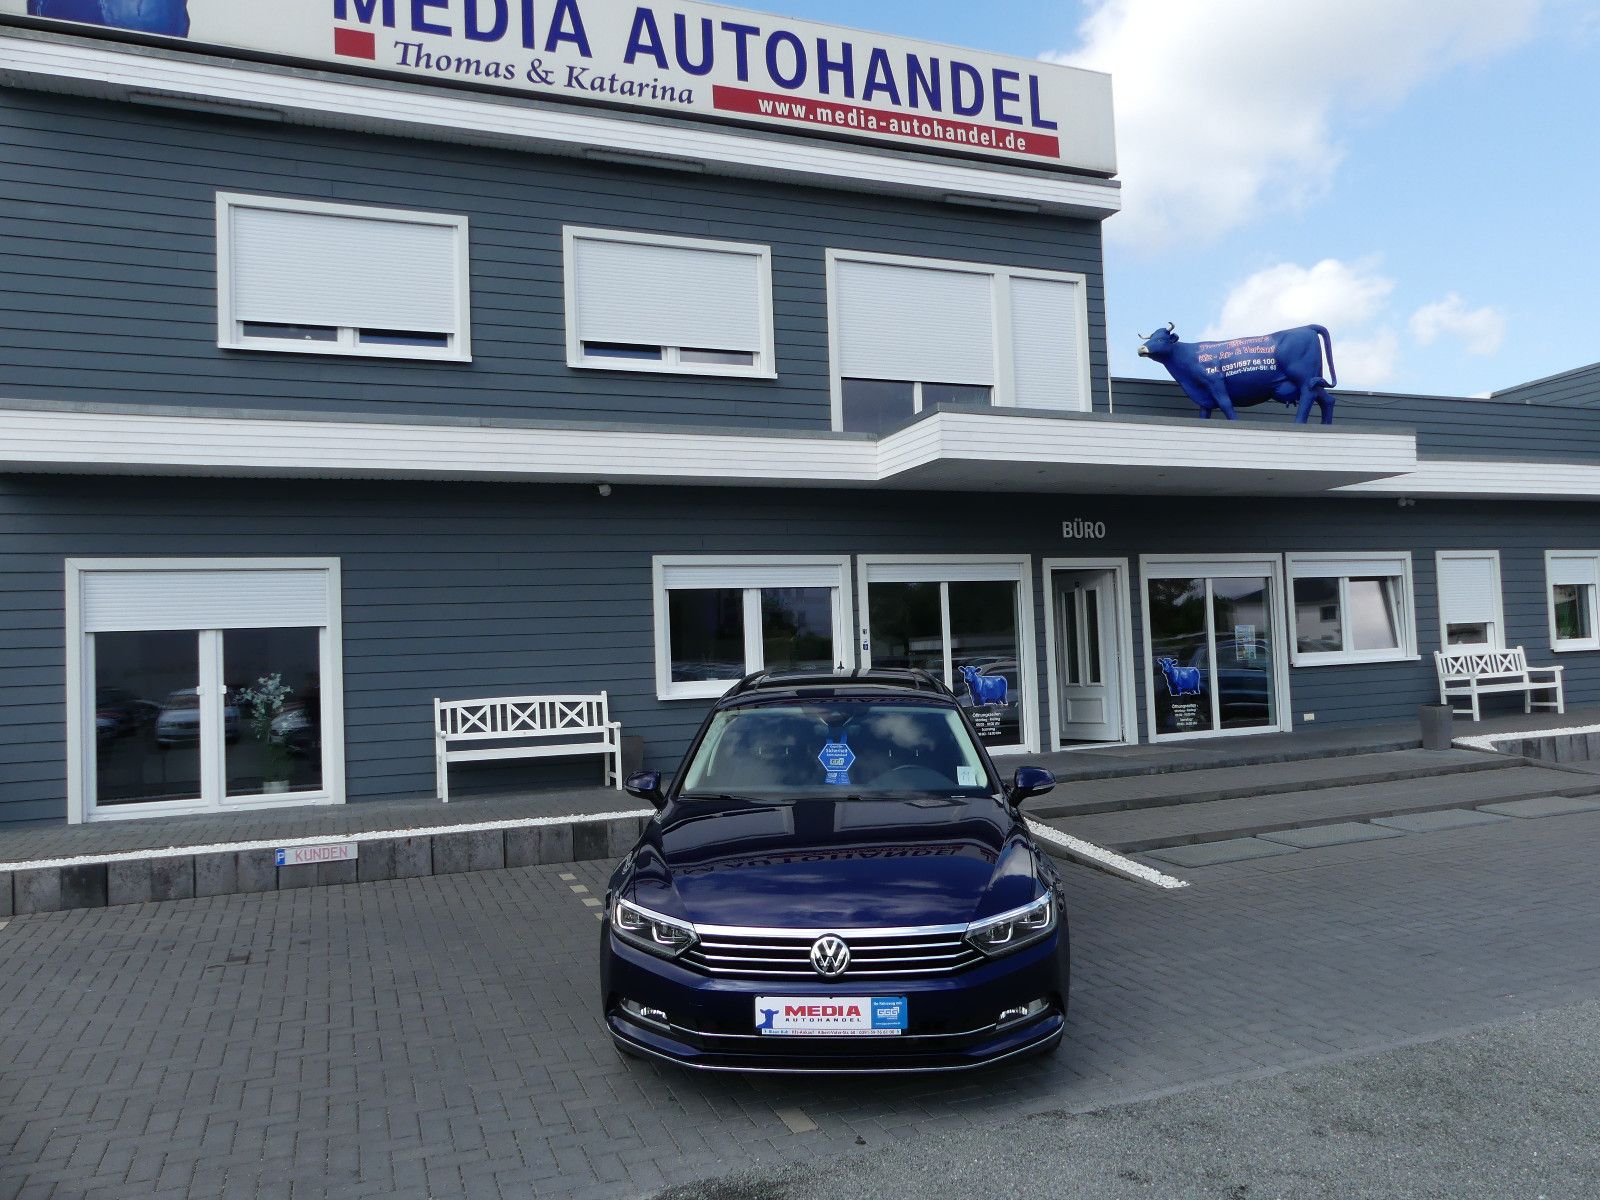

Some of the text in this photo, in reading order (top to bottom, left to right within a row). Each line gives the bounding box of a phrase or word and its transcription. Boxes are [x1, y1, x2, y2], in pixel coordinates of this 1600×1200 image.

[394, 41, 694, 104] Thomas & Katarina
[623, 6, 1058, 130] AUTOHANDEL
[758, 98, 1027, 150] www.media-autohandel.de
[1062, 518, 1106, 539] BÜRO
[295, 846, 348, 862] KUNDEN
[784, 1006, 861, 1016] MEDIA
